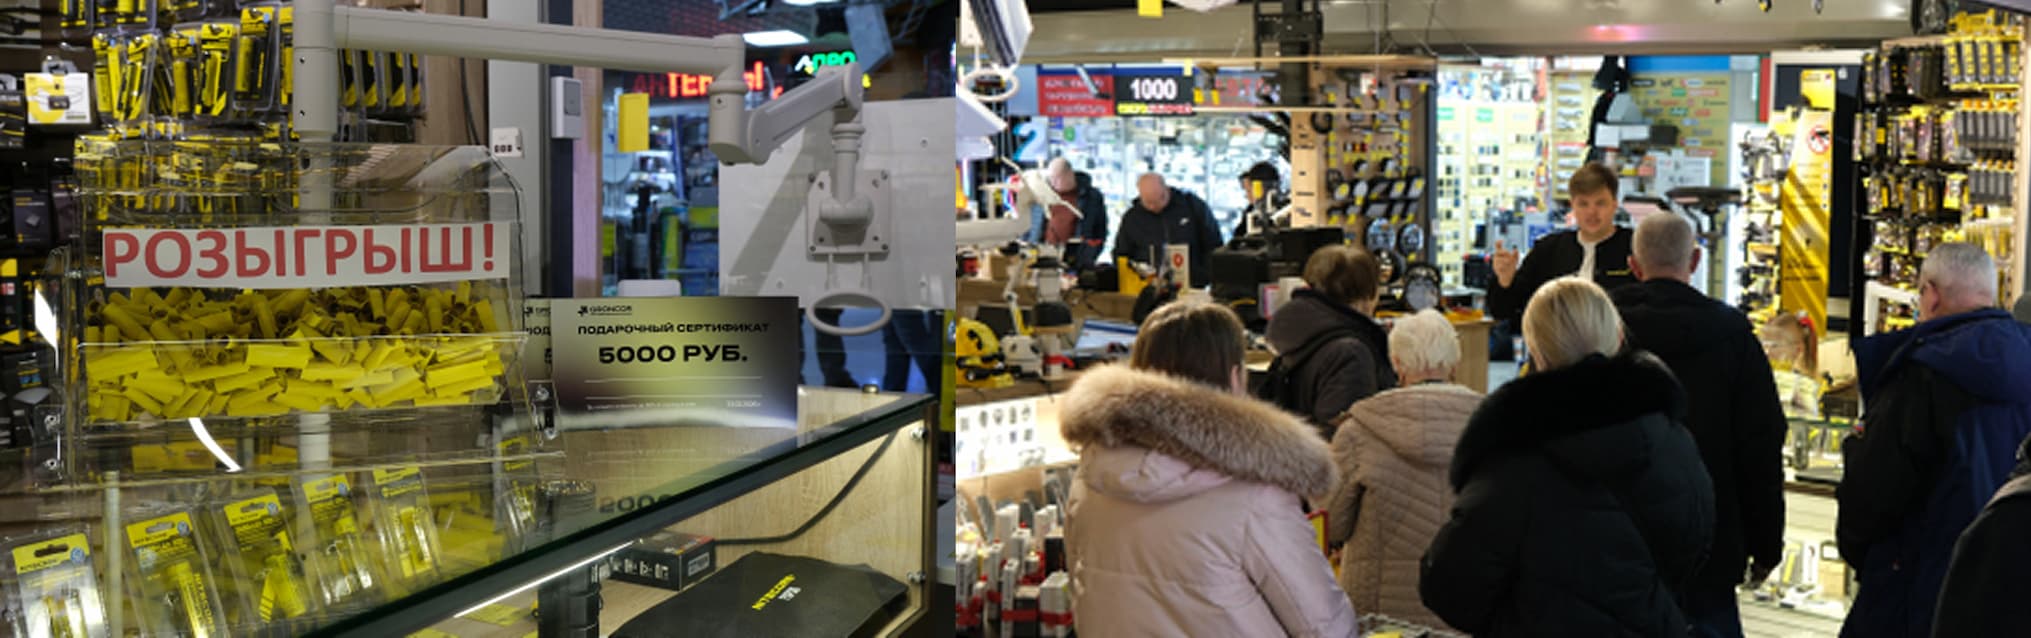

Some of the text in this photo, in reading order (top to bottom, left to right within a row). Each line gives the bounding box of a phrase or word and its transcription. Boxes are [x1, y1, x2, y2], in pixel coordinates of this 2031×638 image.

[1130, 78, 1178, 100] 1000
[104, 223, 494, 279] РОЗЫГРЫШ!
[577, 322, 770, 336] ПОДАРОЧНЫЙ СЕРТИФИКАТ
[599, 344, 748, 364] 5000 РУБ.
